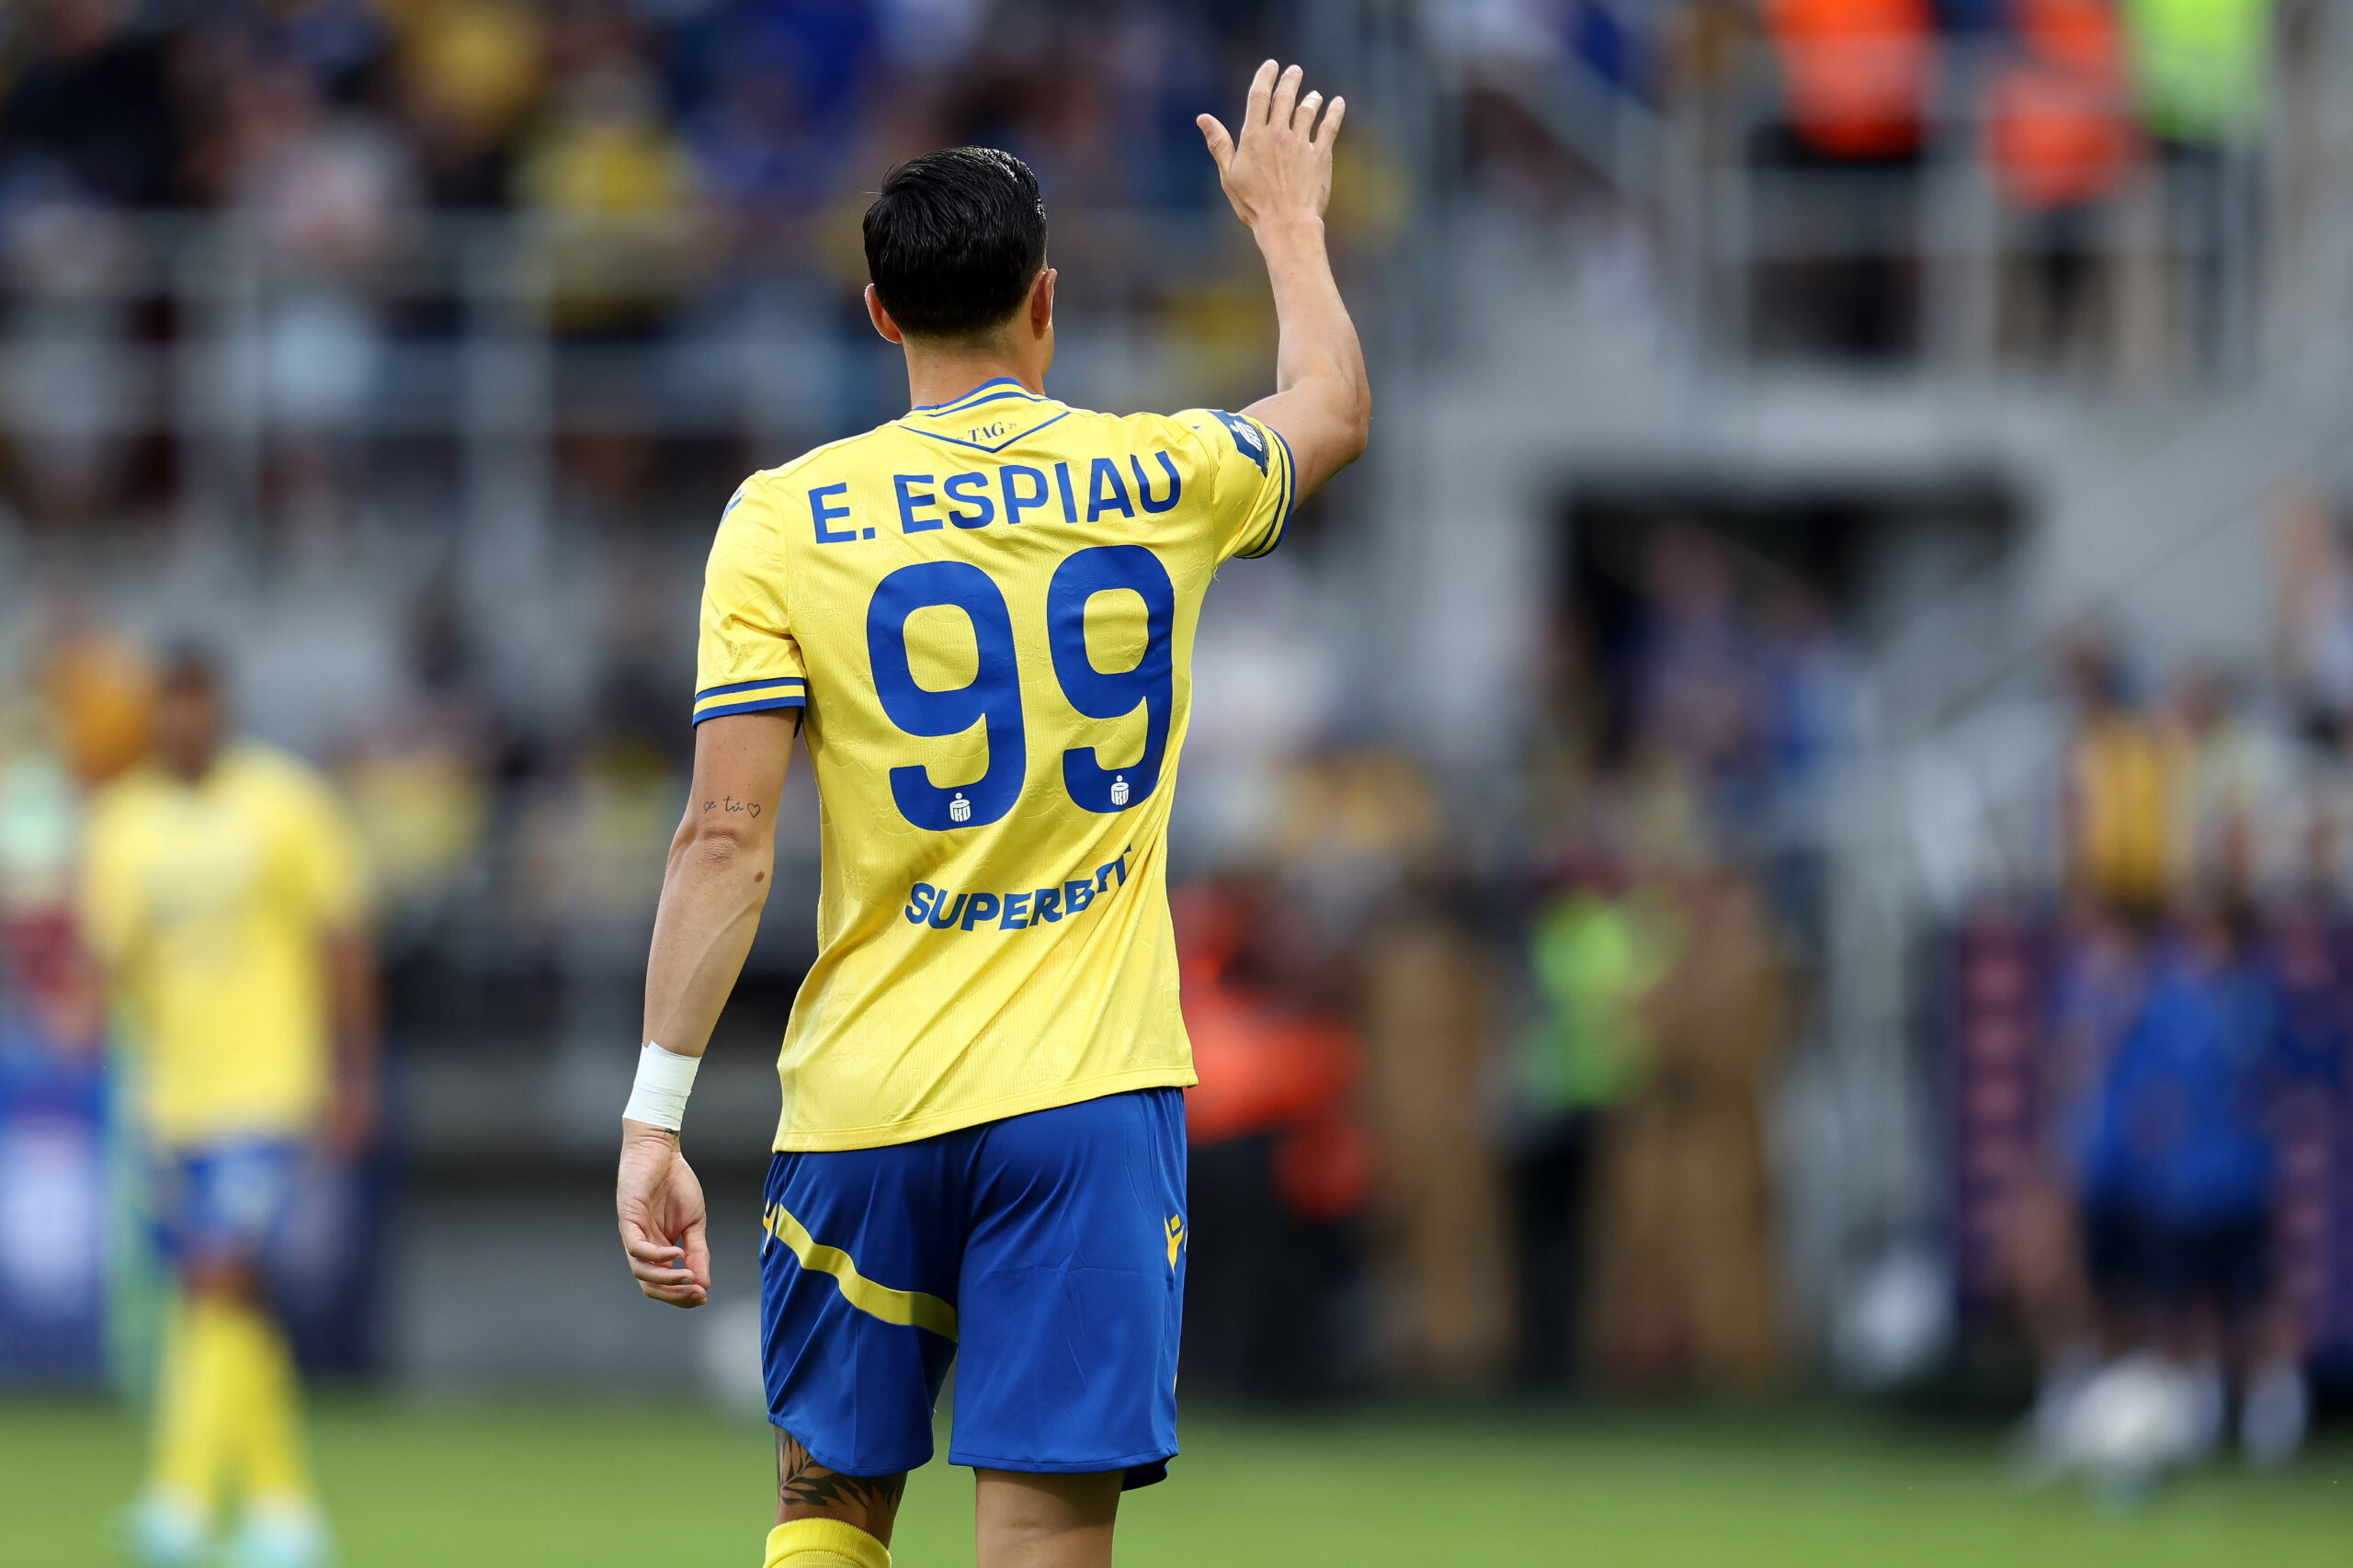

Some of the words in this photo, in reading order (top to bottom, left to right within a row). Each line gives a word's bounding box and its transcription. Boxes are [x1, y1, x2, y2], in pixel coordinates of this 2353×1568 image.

[968, 421, 1006, 442] TAG
[808, 482, 876, 544] E.
[893, 450, 1182, 534] ESPIAU
[867, 544, 1176, 832] 99
